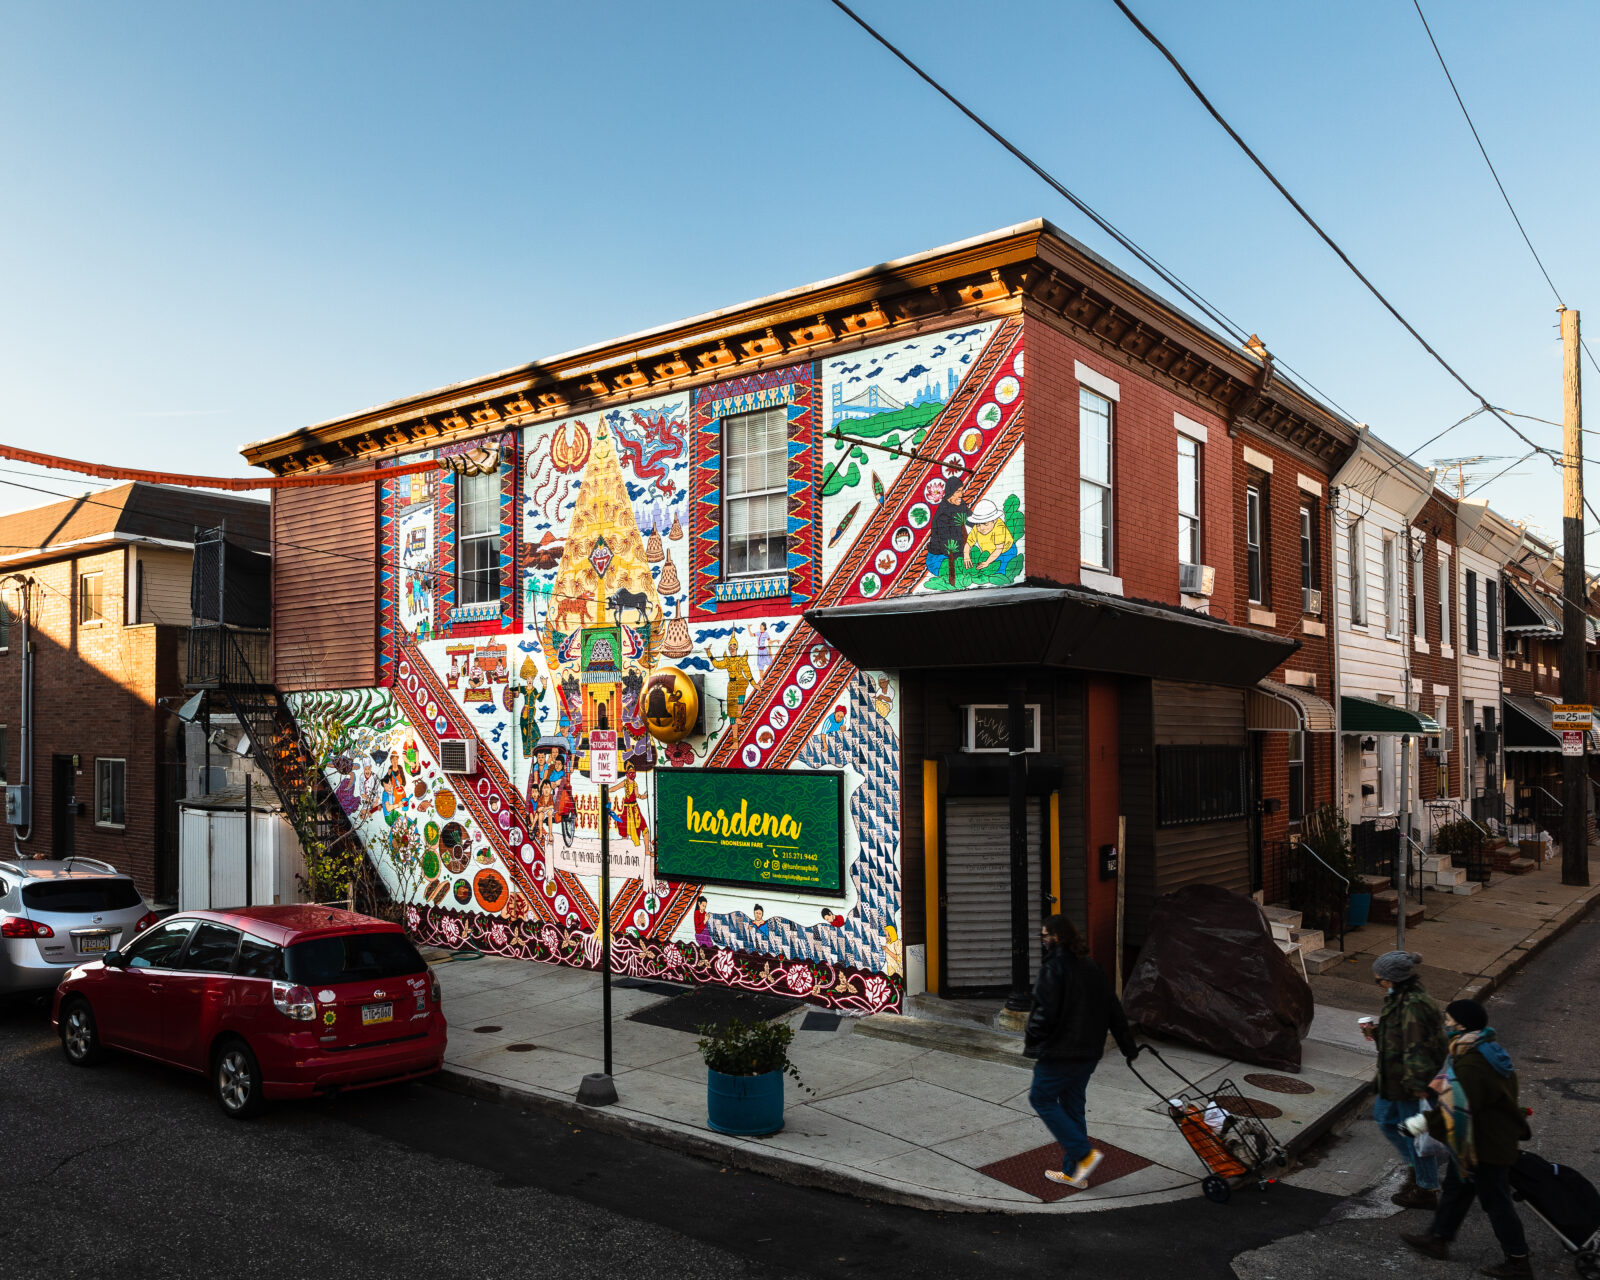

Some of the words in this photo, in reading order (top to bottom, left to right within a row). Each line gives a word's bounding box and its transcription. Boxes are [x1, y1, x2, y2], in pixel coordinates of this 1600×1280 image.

[1566, 713, 1578, 721] 25
[598, 752, 610, 760] ANY
[598, 762, 610, 770] TIME
[687, 795, 802, 840] hardena
